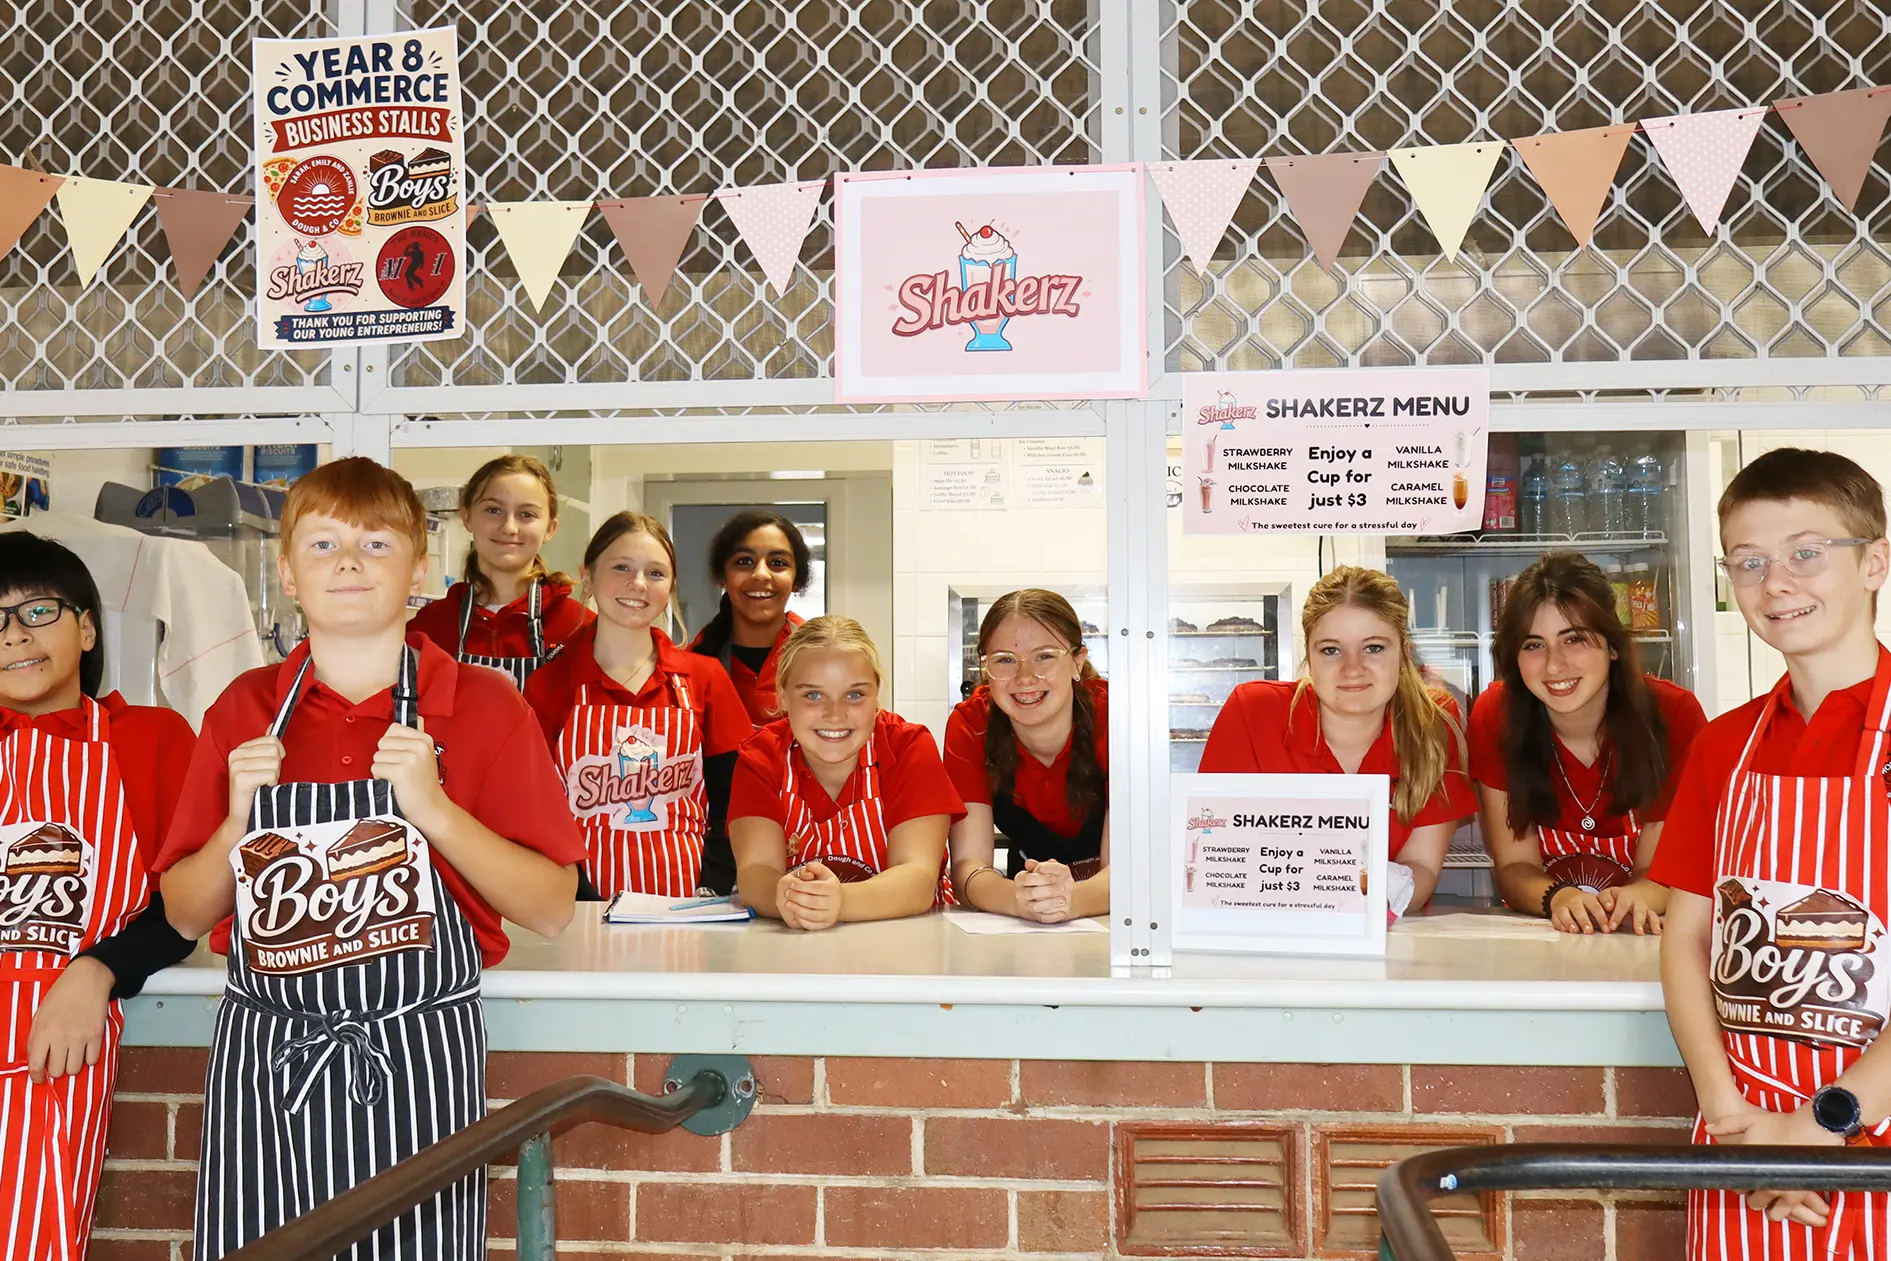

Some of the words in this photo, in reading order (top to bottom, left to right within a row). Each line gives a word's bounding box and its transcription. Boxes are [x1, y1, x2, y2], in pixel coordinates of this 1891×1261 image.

[293, 42, 394, 82] YEAR
[401, 39, 424, 73] 8
[267, 73, 449, 116] COMMERCE
[284, 111, 374, 147] BUSINESS
[378, 110, 441, 137] STALLS
[311, 159, 332, 168] EMILY
[331, 161, 346, 173] AND
[370, 164, 448, 208] Boys
[374, 209, 411, 222] BROWNIE
[413, 210, 428, 218] AND
[428, 202, 451, 216] SLICE
[292, 219, 320, 234] DOUGH
[328, 218, 340, 228] CO
[267, 260, 365, 301] Shakerz
[892, 262, 1083, 337] Shakerz
[292, 317, 330, 328] THANK
[332, 316, 353, 326] YOU
[356, 314, 376, 326] FOR
[379, 310, 443, 324] SUPPORTING
[292, 329, 316, 340] OUR
[318, 326, 354, 338] YOUNG
[357, 320, 443, 336] ENTREPRENEURS!
[1196, 402, 1258, 426] Shakerz
[1265, 397, 1386, 419] SHAKERZ
[1392, 396, 1471, 417] MENU
[7, 452, 26, 462] simple
[1222, 448, 1294, 458] STRAWBERRY
[1308, 446, 1357, 464] Enjoy
[1362, 449, 1372, 460] a
[1395, 446, 1443, 455] VANILLA
[4, 461, 17, 470] safe
[18, 462, 31, 473] food
[1228, 462, 1288, 471] MILKSHAKE
[1387, 460, 1450, 469] MILKSHAKE
[1306, 470, 1342, 487] Cup
[1345, 469, 1372, 484] for
[1228, 484, 1291, 494] CHOCOLATE
[1390, 482, 1444, 492] CARAMEL
[1230, 498, 1288, 506] MILKSHAKE
[1308, 494, 1343, 510] just
[1347, 492, 1368, 508] $3
[1386, 496, 1448, 506] MILKSHAKE
[1359, 522, 1399, 530] stressful
[1401, 522, 1418, 530] day
[576, 759, 696, 811] Shakerz
[1186, 816, 1228, 831] Shakerz
[1232, 814, 1313, 829] SHAKERZ
[1318, 816, 1370, 830] MENU
[828, 855, 851, 864] Dough
[852, 859, 865, 869] and
[1260, 847, 1292, 860] Enjoy
[1259, 864, 1282, 876] Cup
[1285, 864, 1304, 874] for
[1260, 881, 1284, 892] just
[1287, 880, 1300, 892] $3
[0, 874, 80, 927] ys
[252, 855, 411, 939] Boys
[0, 930, 21, 941] ND
[257, 942, 329, 969] BROWNIE
[333, 940, 364, 957] AND
[368, 923, 420, 949] SLICE
[1717, 908, 1863, 1009] Boys
[1764, 1012, 1795, 1026] AND
[1800, 1012, 1864, 1038] SLICE
